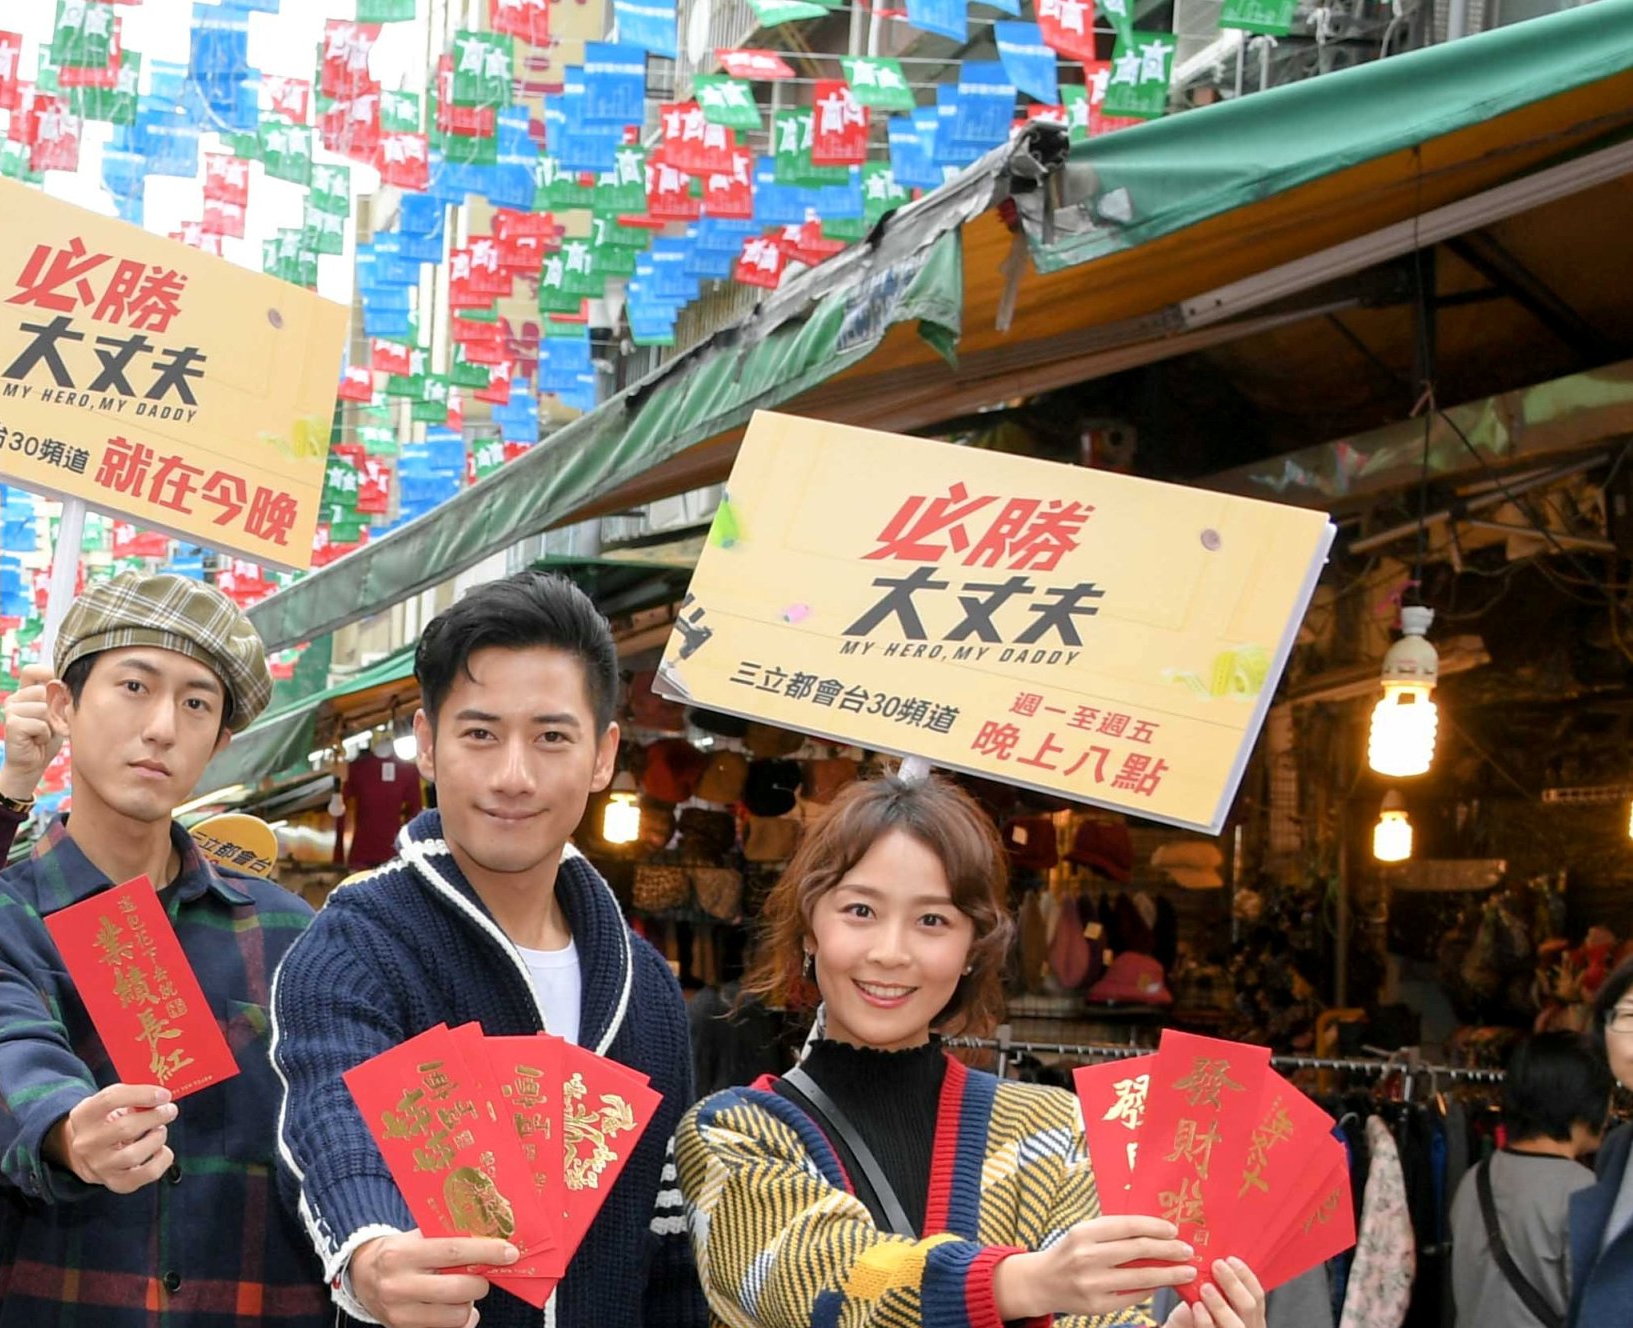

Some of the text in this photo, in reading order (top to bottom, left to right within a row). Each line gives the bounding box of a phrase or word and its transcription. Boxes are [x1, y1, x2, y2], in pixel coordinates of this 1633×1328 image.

[4, 237, 189, 334] 必勝
[1, 316, 208, 407] 大丈夫
[2, 383, 31, 399] MY
[135, 401, 199, 424] DADDY
[93, 434, 298, 547] 就在今晚
[860, 482, 1096, 573] 必勝
[841, 566, 1105, 648] 大丈夫
[839, 640, 878, 656] MY
[999, 648, 1081, 668] DADDY
[729, 660, 961, 735] 三立都會台30頻道
[1008, 690, 1161, 745] 週一至週五
[970, 719, 1171, 798] 晚上八點
[92, 915, 195, 1086] 業績長紅
